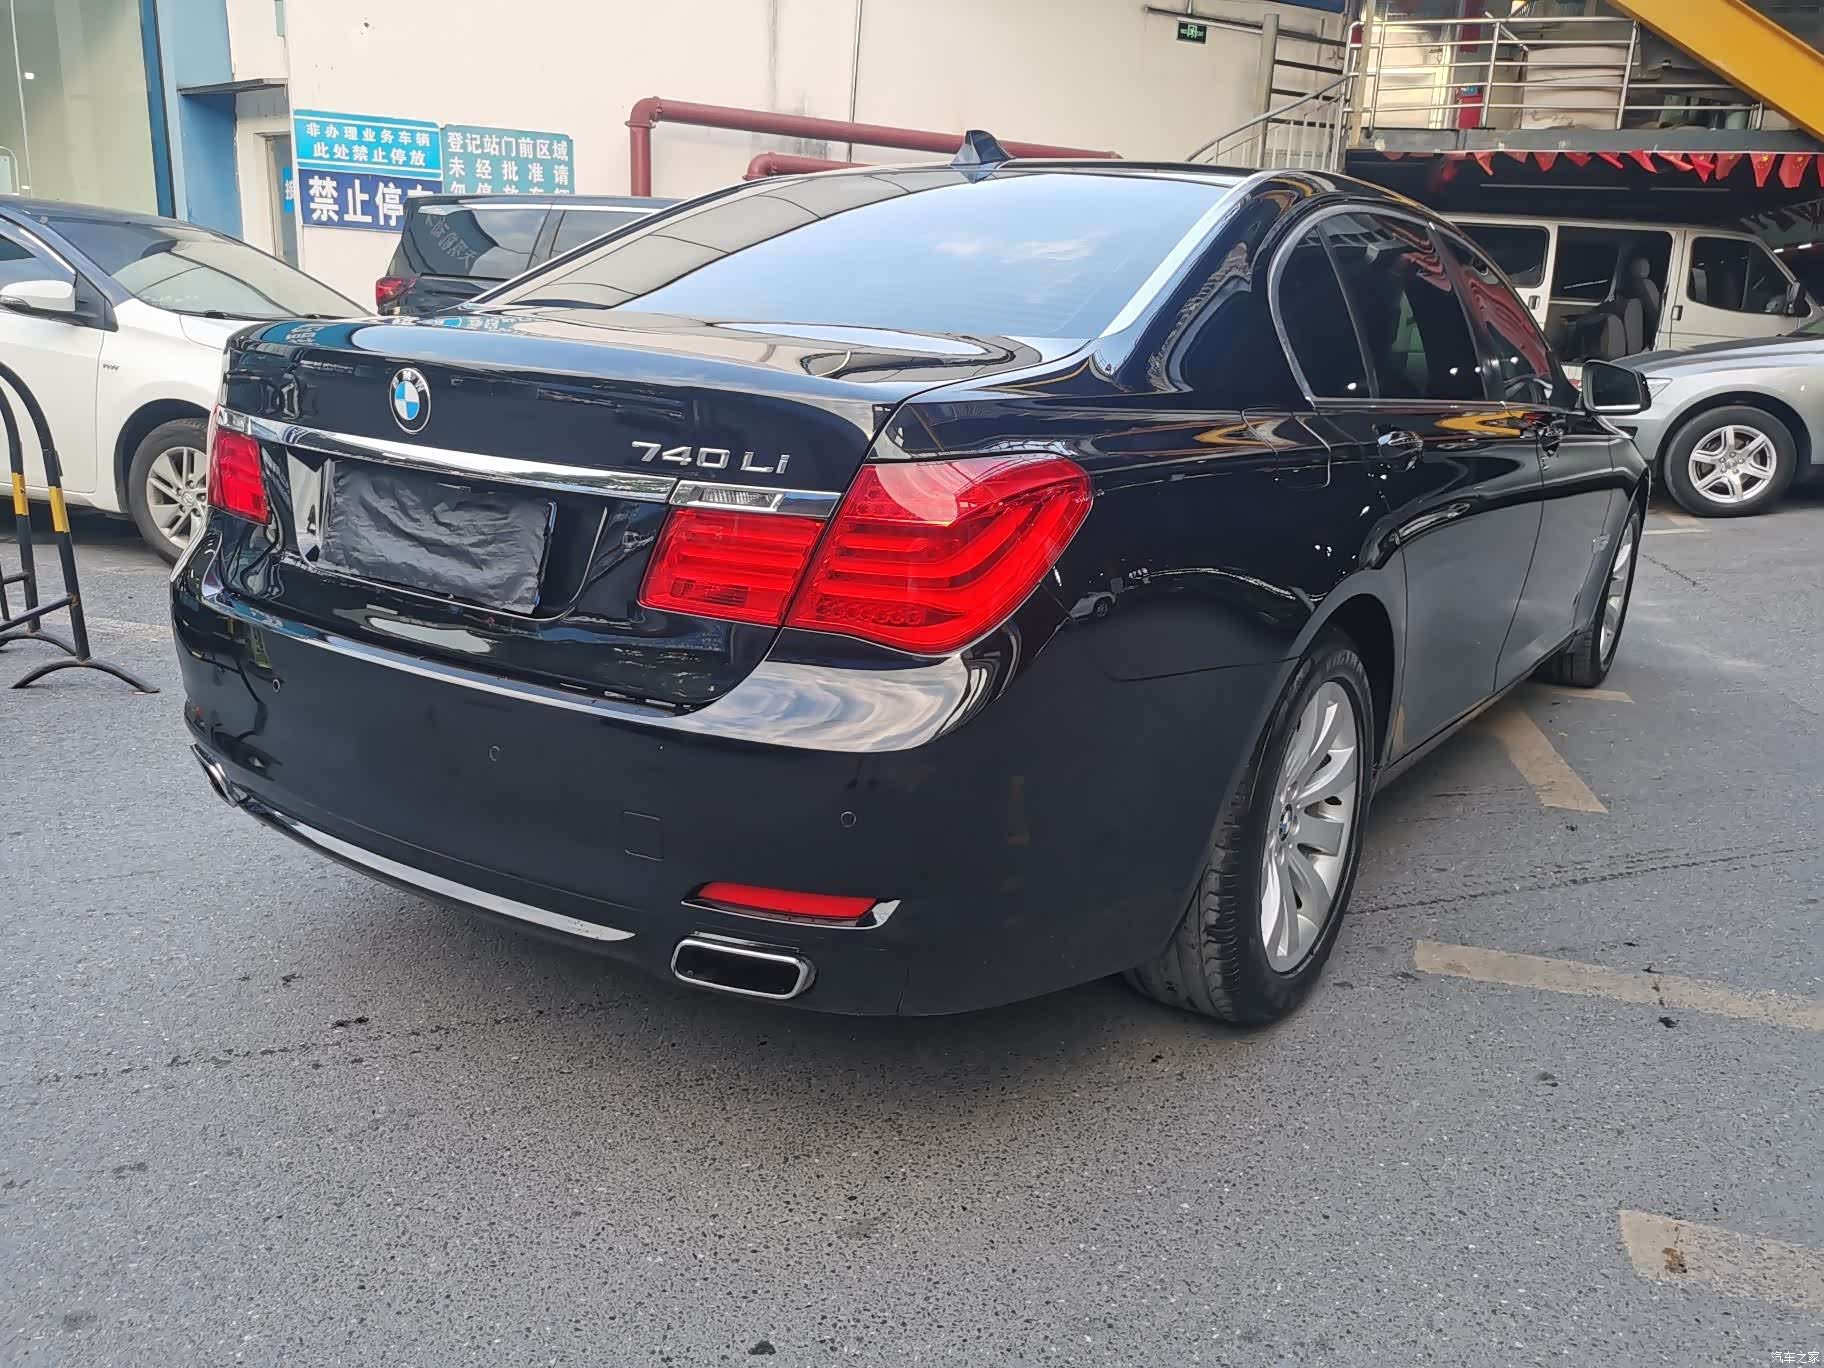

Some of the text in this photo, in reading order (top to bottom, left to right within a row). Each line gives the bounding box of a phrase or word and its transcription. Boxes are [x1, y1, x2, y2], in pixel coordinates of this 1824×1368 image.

[306, 121, 431, 147] 非办理业务车辆
[447, 131, 569, 161] 登记站门前区域
[312, 141, 426, 167] 此处禁止停放
[448, 156, 569, 186] 未经批准请
[392, 370, 426, 393] BMW
[631, 440, 791, 474] 740 Li
